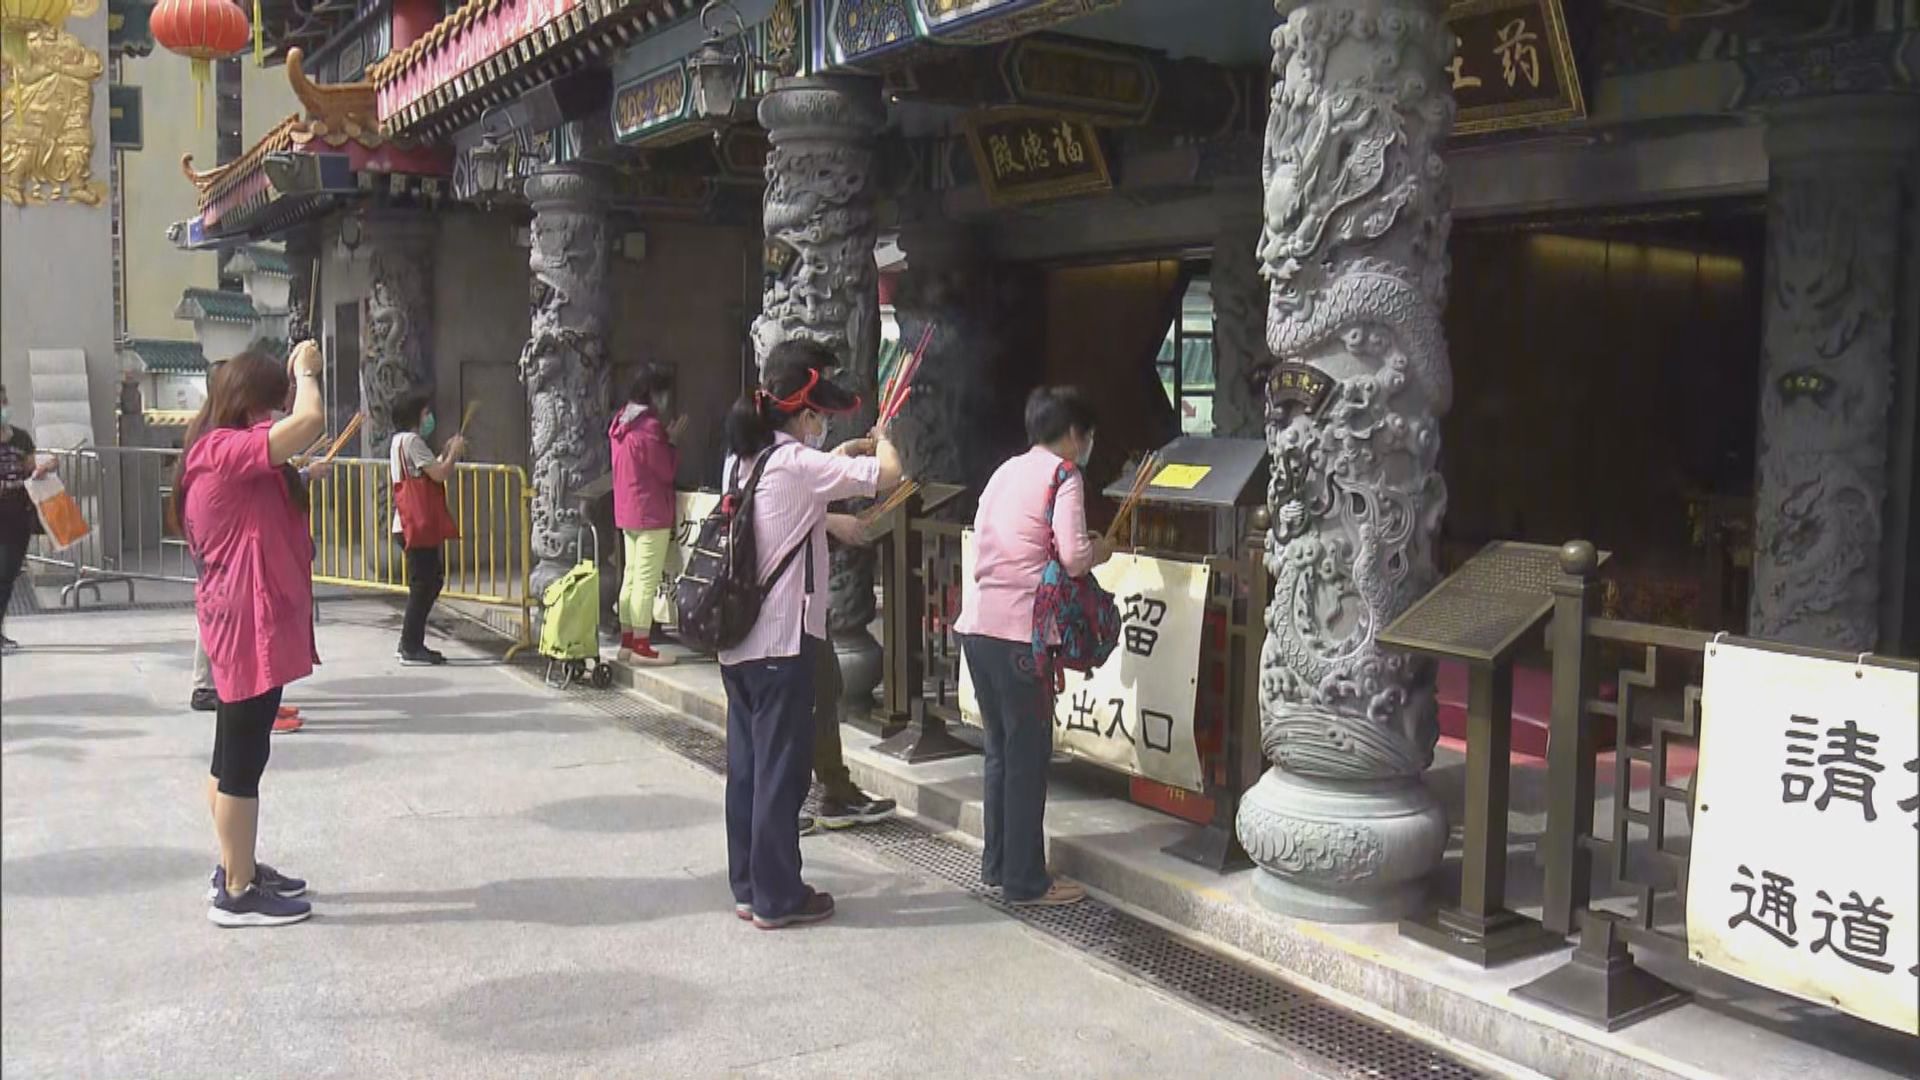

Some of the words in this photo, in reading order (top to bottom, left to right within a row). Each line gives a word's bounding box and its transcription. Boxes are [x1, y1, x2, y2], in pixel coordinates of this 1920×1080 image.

[1122, 593, 1168, 657] 留
[1053, 688, 1174, 754] 出入口
[1728, 864, 1919, 977] 通道
